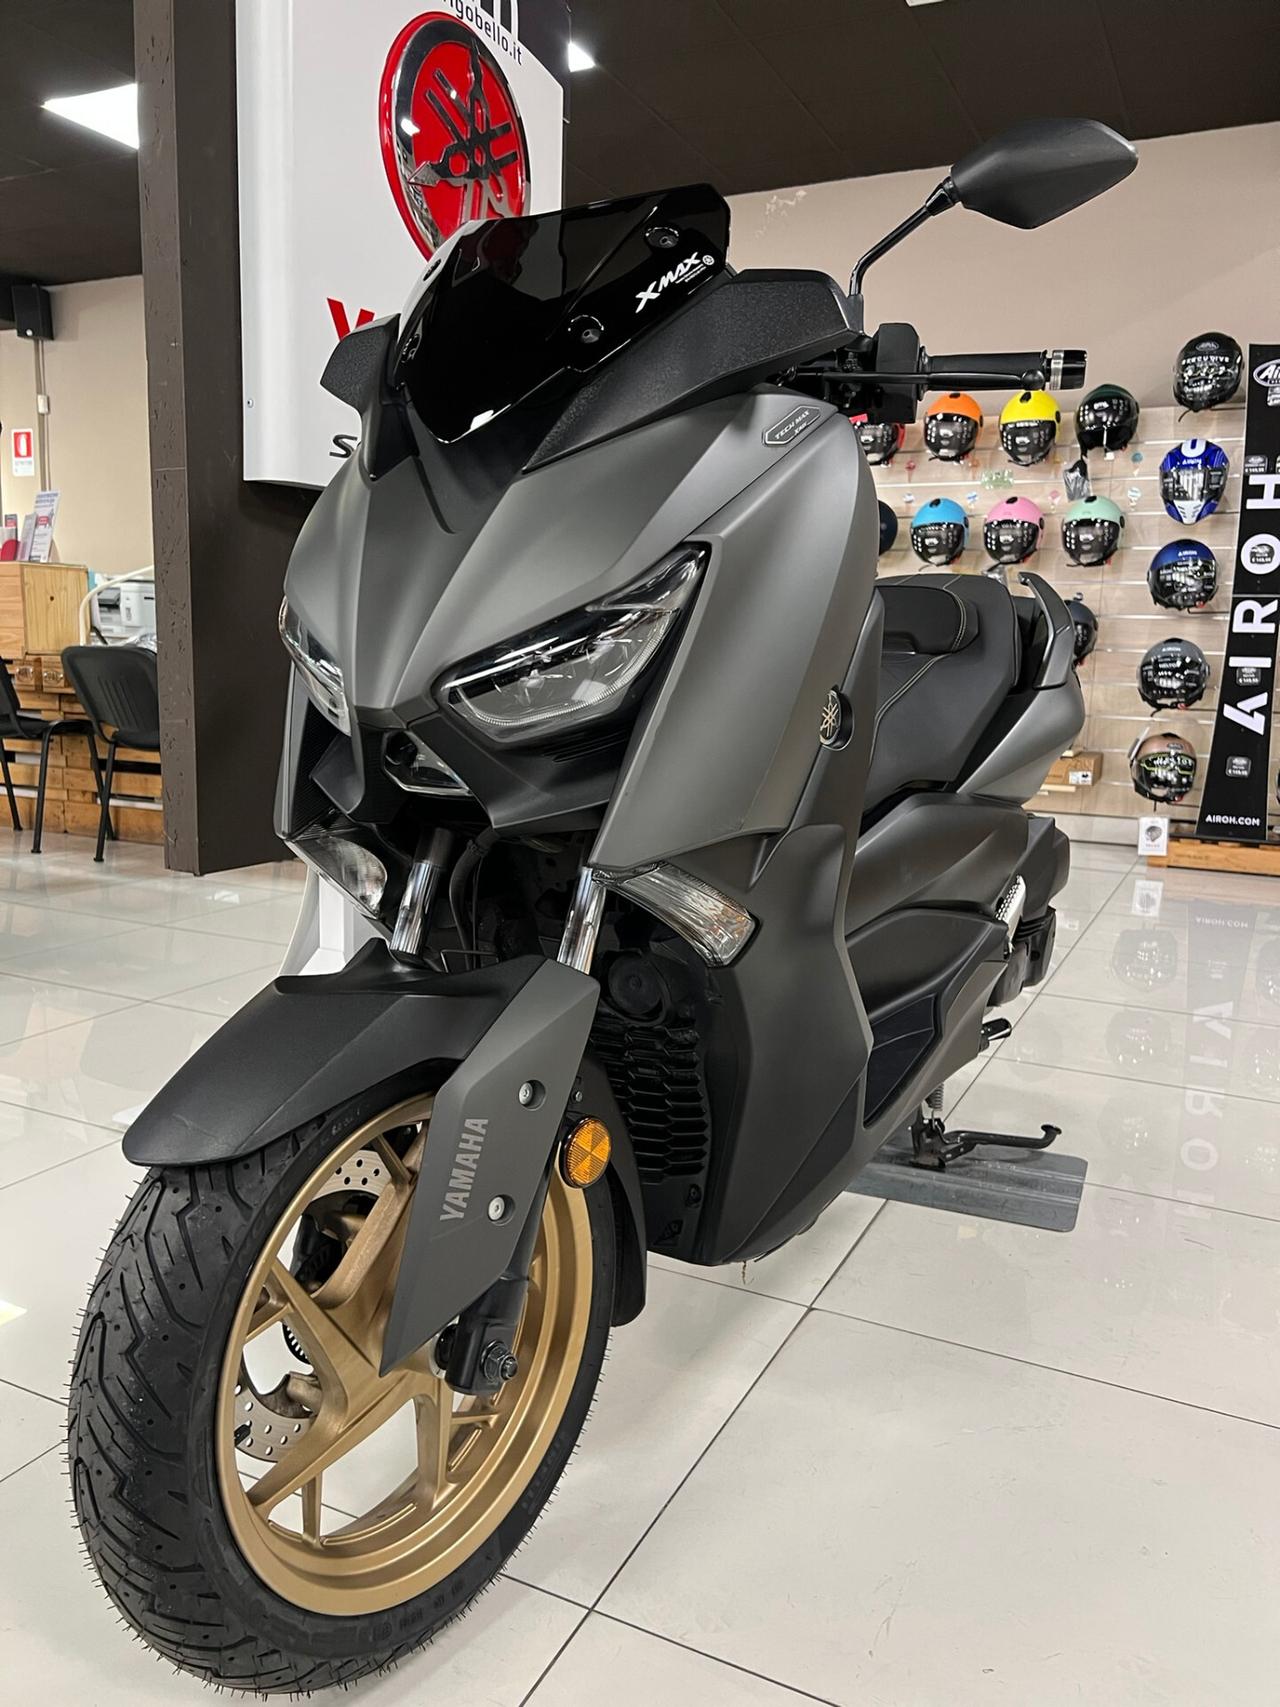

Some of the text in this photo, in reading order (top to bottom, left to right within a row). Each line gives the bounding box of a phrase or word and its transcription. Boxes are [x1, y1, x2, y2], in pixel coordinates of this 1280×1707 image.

[1223, 474, 1280, 735] AIROH
[1205, 814, 1260, 826] AIROH.COM
[440, 1118, 489, 1221] YAMAHA
